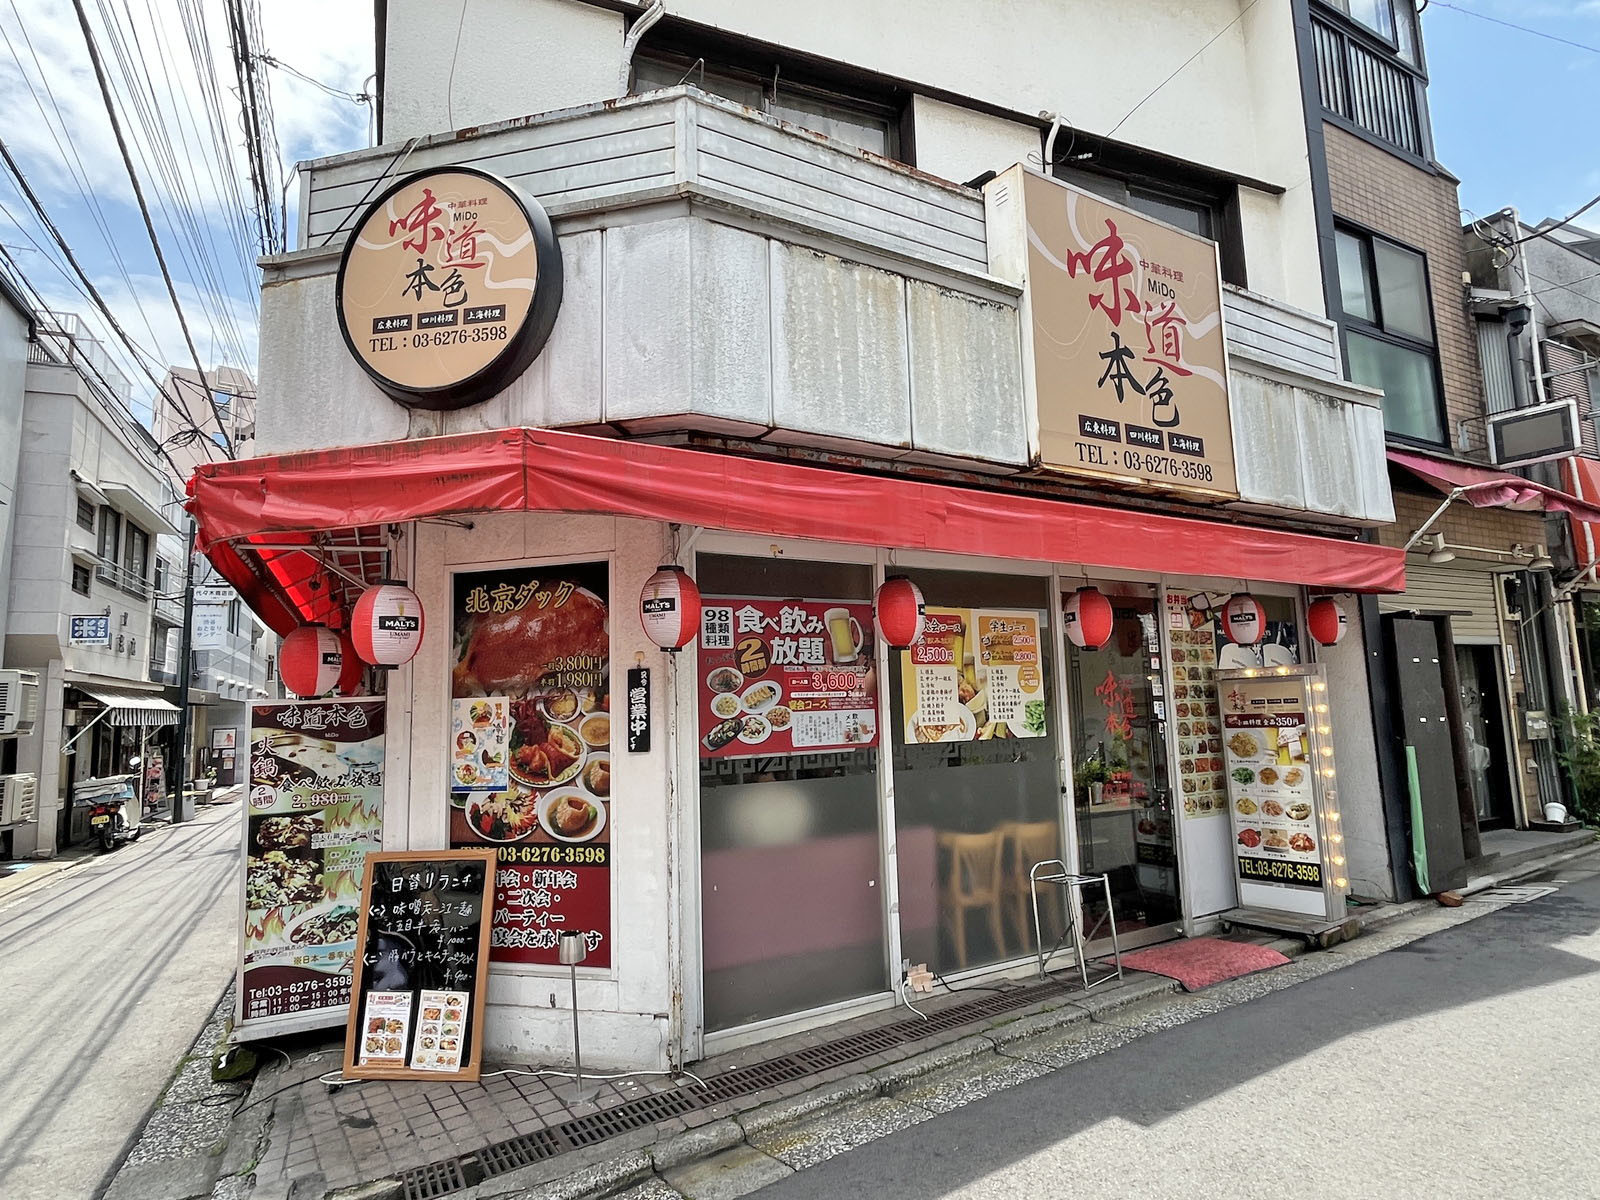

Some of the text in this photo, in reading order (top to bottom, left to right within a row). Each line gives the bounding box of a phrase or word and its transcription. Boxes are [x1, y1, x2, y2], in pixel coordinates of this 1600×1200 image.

[447, 197, 488, 210] 中華料理
[452, 211, 478, 223] MiDo
[1139, 258, 1184, 283] 中華料理
[1147, 278, 1176, 299] MiDo
[421, 312, 454, 325] 四川料理
[467, 308, 501, 320] 上海料理
[1129, 429, 1160, 444] 四川料理
[465, 580, 575, 613] 北京ダック
[705, 609, 730, 622] 98
[735, 604, 825, 634] 食べ飲み
[705, 622, 730, 634] 種類
[990, 619, 1027, 633] 学生コース
[705, 635, 731, 647] 料理
[771, 636, 825, 664] 放題
[277, 704, 368, 730] 味道本色
[277, 771, 382, 793] 食べ飲み放題
